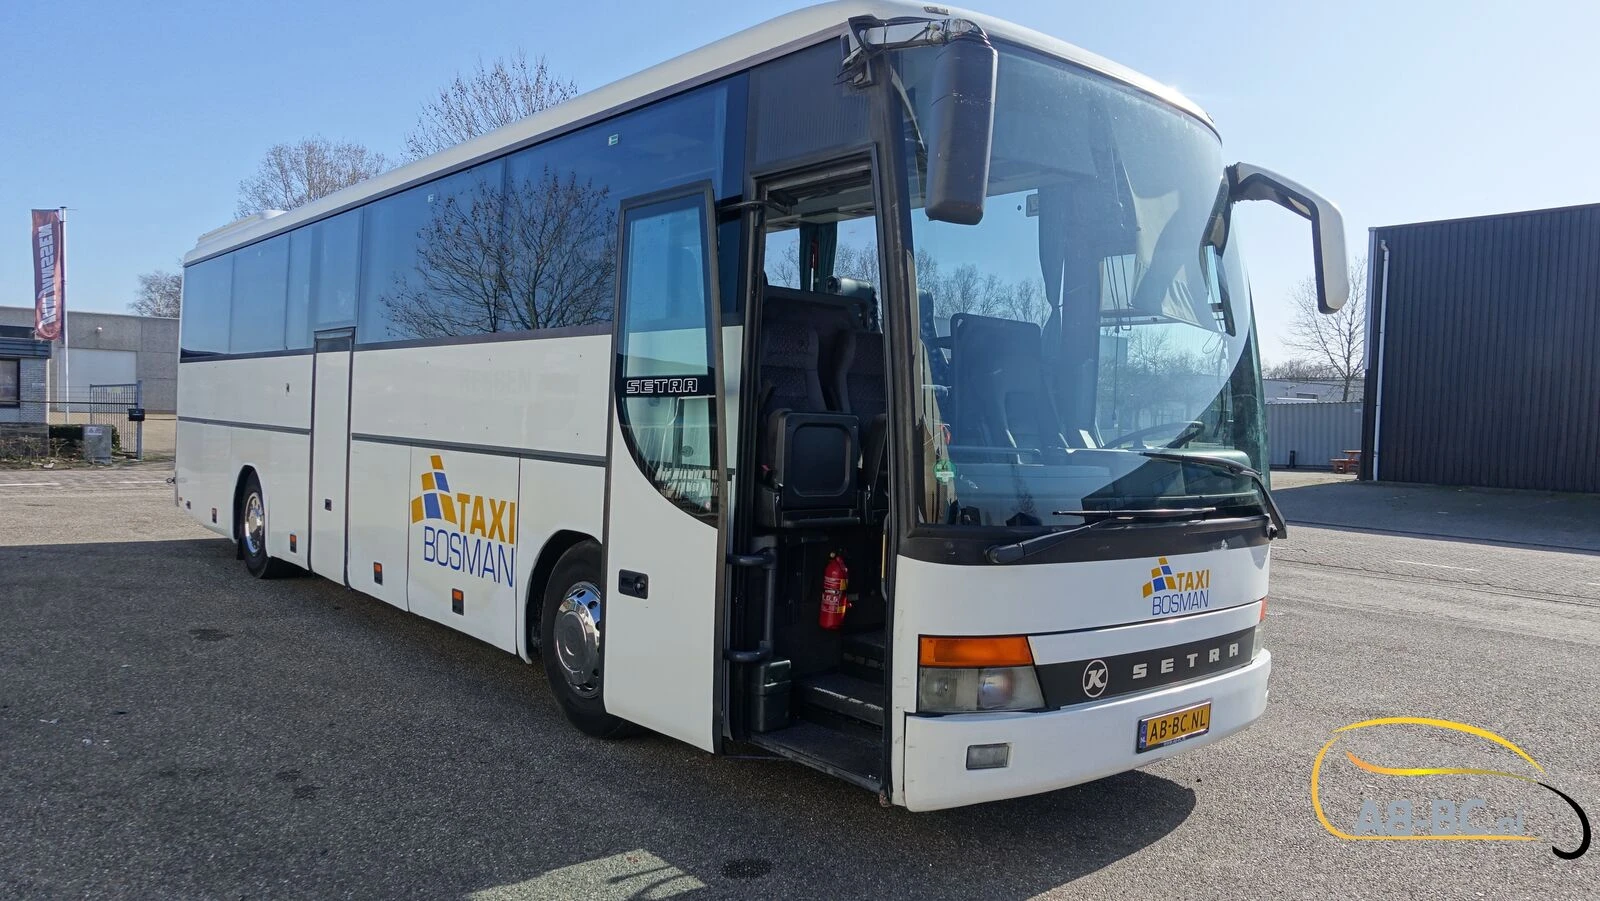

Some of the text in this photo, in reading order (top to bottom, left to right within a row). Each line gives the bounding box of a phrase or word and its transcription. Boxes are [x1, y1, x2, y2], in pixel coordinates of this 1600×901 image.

[626, 378, 698, 394] SETRA
[457, 493, 516, 545] TAXI
[424, 526, 515, 588] BOSMAN
[1176, 569, 1210, 593] TAXI
[1152, 590, 1209, 616] BOSMAN
[1132, 643, 1239, 680] SETRA
[1149, 709, 1206, 742] AB-BC.NL
